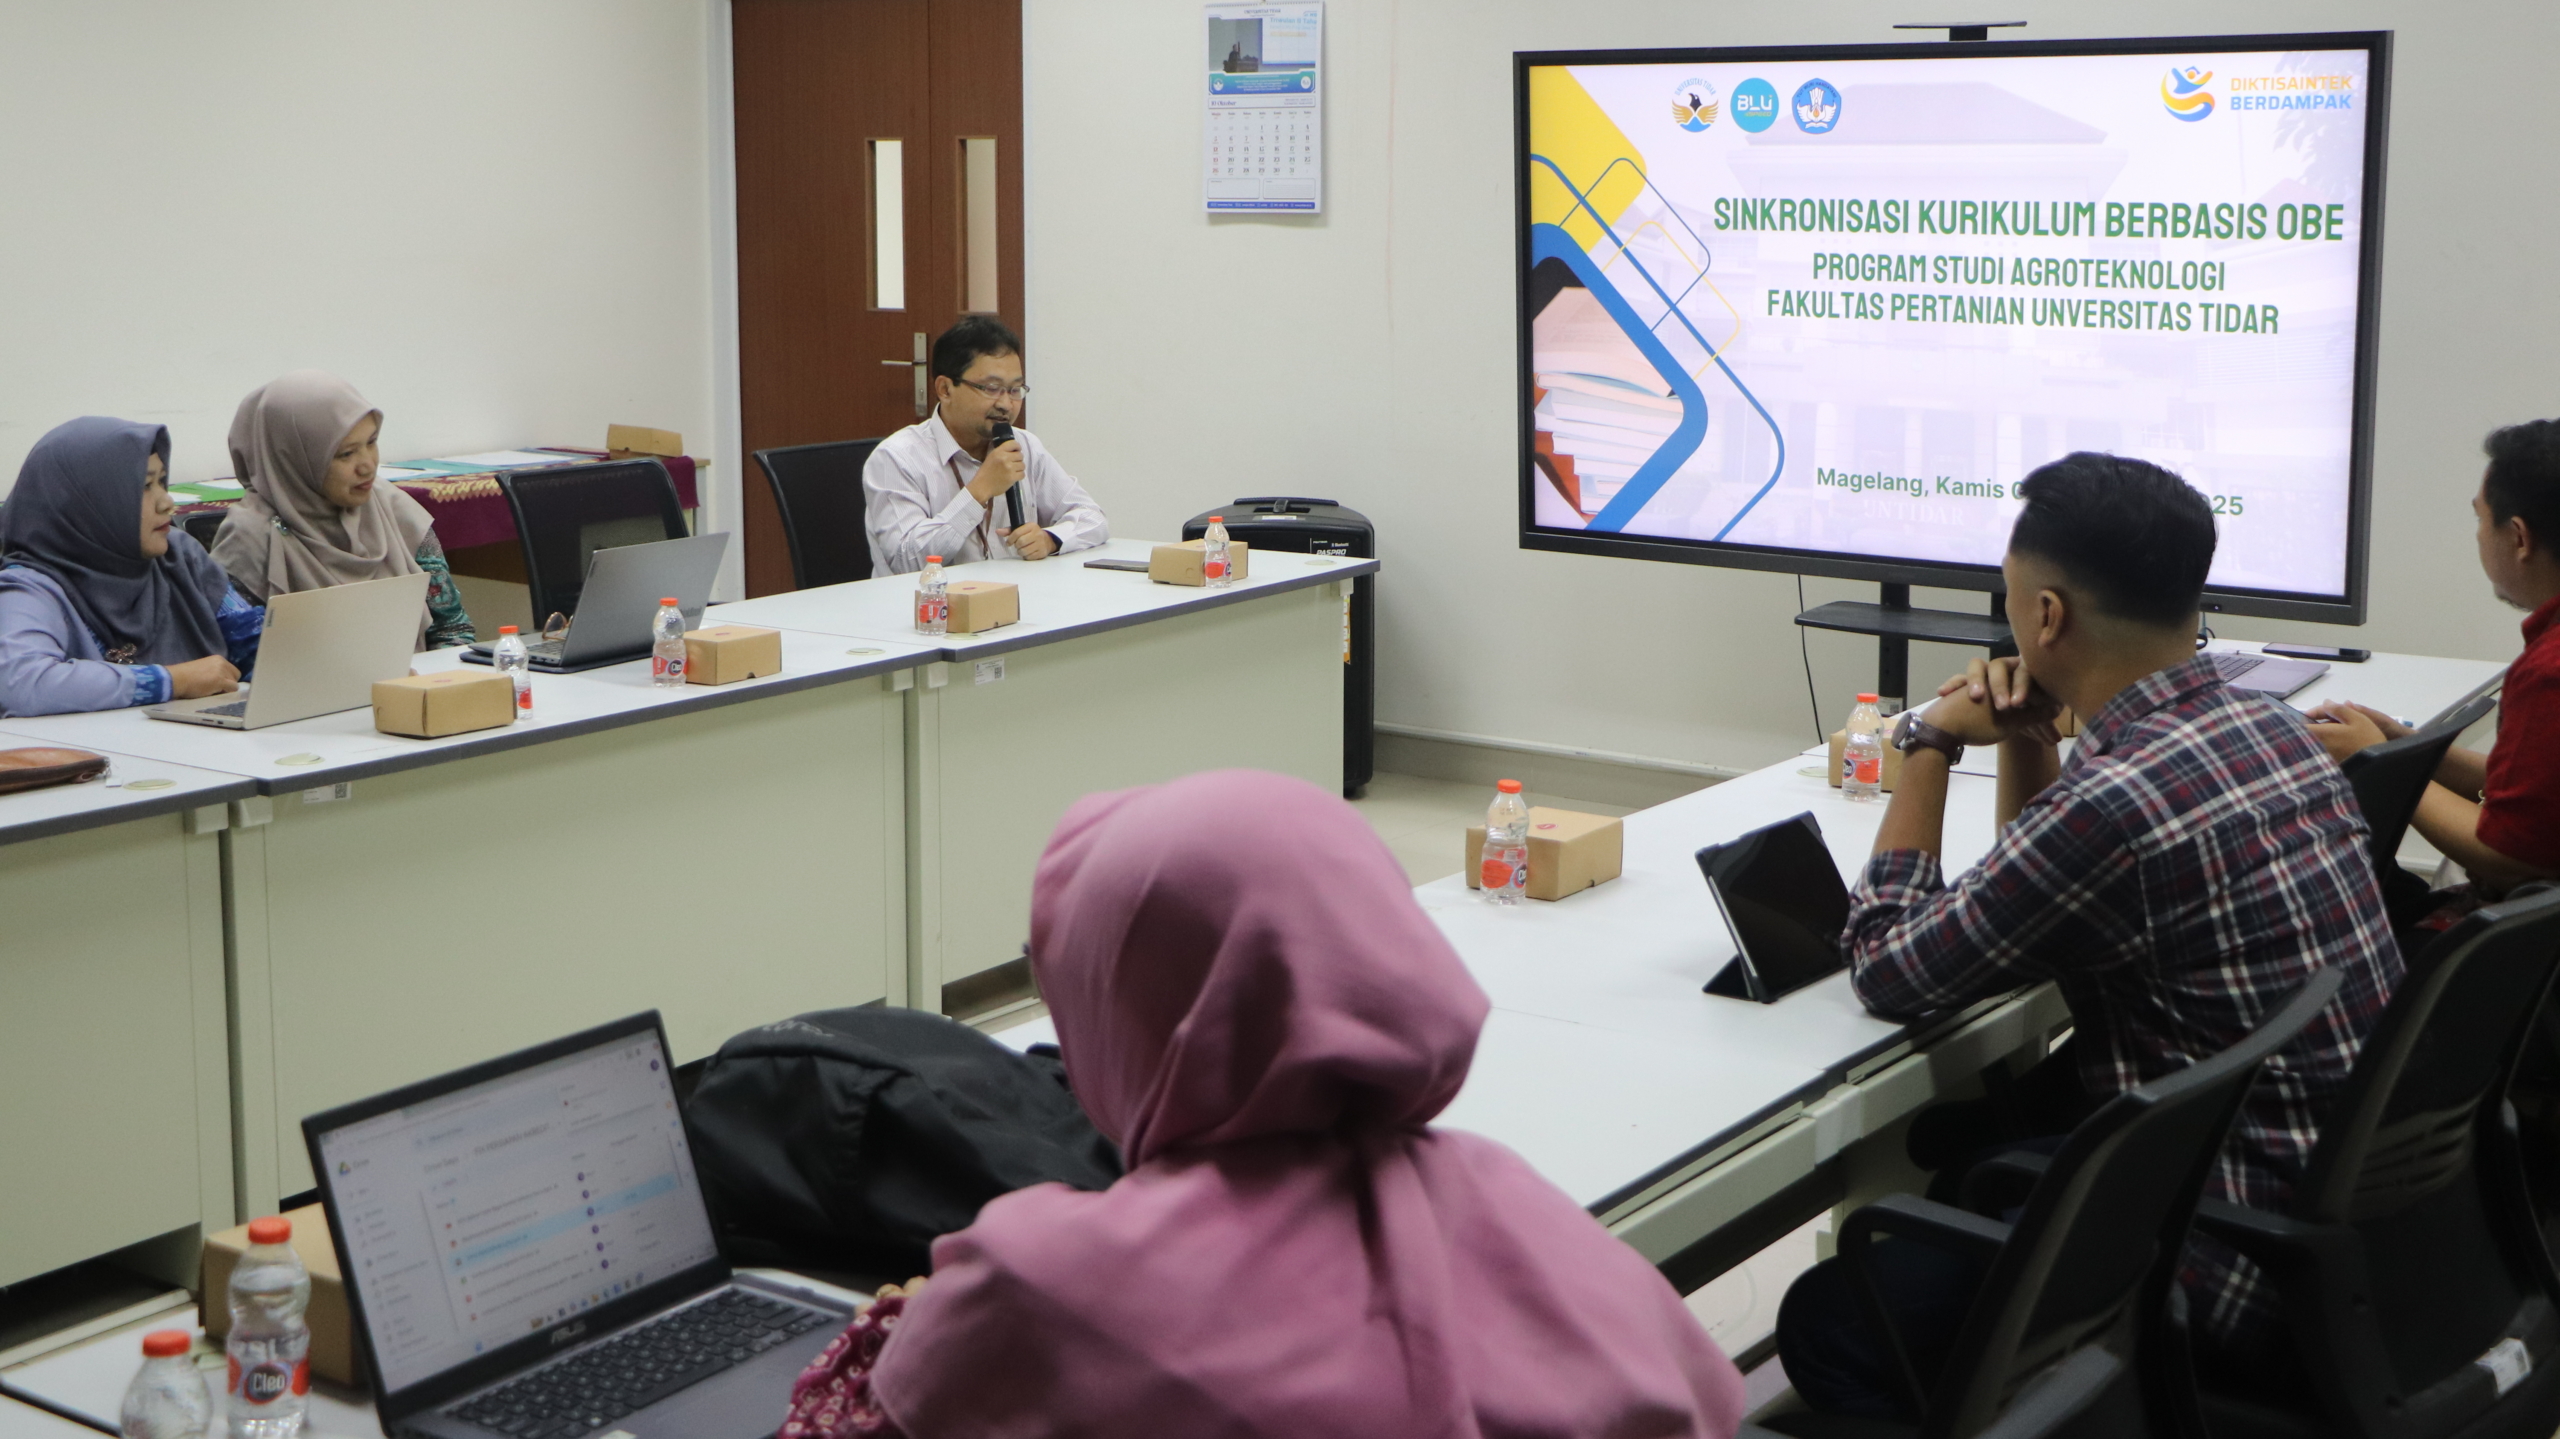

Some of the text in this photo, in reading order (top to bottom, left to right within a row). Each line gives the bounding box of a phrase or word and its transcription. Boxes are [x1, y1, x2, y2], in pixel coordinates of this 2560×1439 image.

[1674, 77, 1716, 96] UNIVERSITAS TIDAR
[2230, 75, 2353, 92] DIKTISAINTEK
[1737, 94, 1773, 111] BLU
[2230, 94, 2352, 111] BERDAMPAK
[1714, 197, 2344, 241] SINKRONISASI KURIKULUM BERBASIS OBE
[1813, 252, 2225, 291] PROGRAM STUDI AGROTEKNOLOGI
[1767, 289, 2279, 334] FAKULTAS PERTANIAN UNVERSITAS TIDAR
[1817, 467, 1929, 497] Magelang,
[1936, 475, 2004, 499] Kamis
[2202, 494, 2243, 515] 25
[253, 1372, 286, 1392] Cleo
